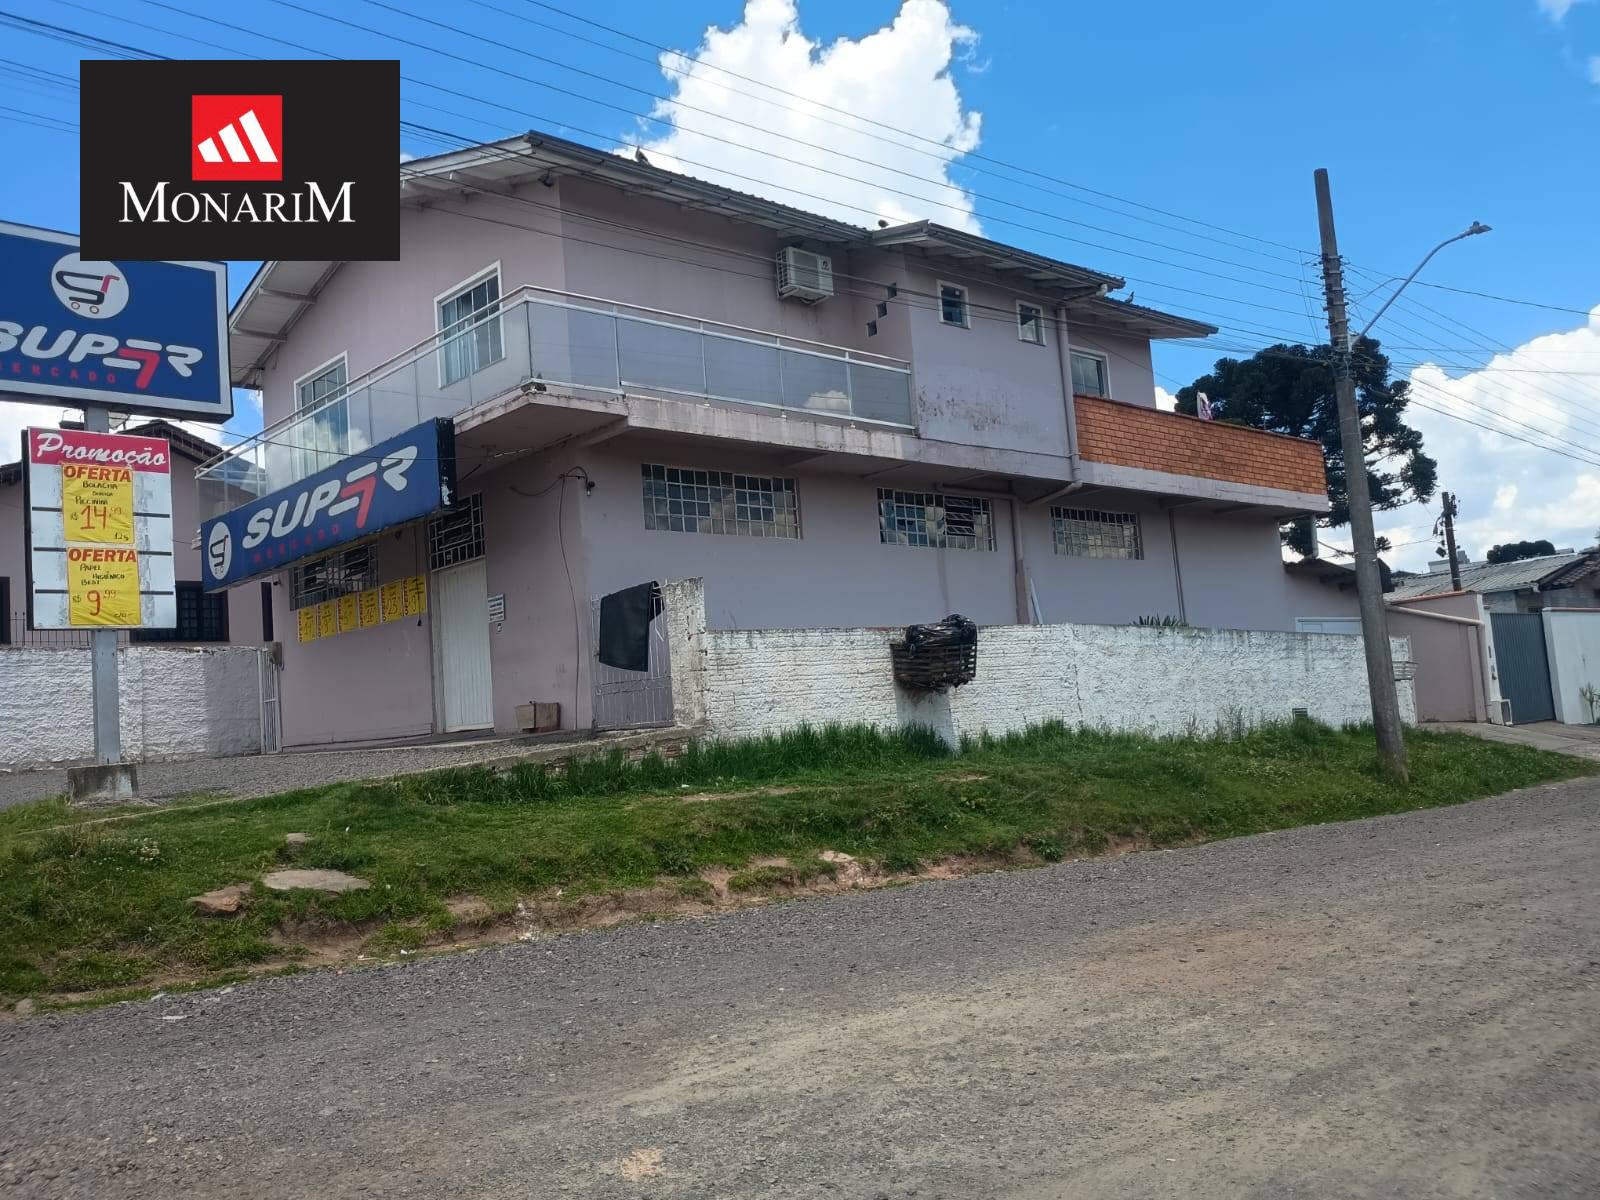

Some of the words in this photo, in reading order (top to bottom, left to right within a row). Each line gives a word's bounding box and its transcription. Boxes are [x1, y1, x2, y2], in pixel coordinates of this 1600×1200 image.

[0, 360, 117, 384] ERCADO
[37, 433, 167, 468] Promoção
[64, 465, 131, 482] OFERTA
[68, 548, 137, 562] OFERTA
